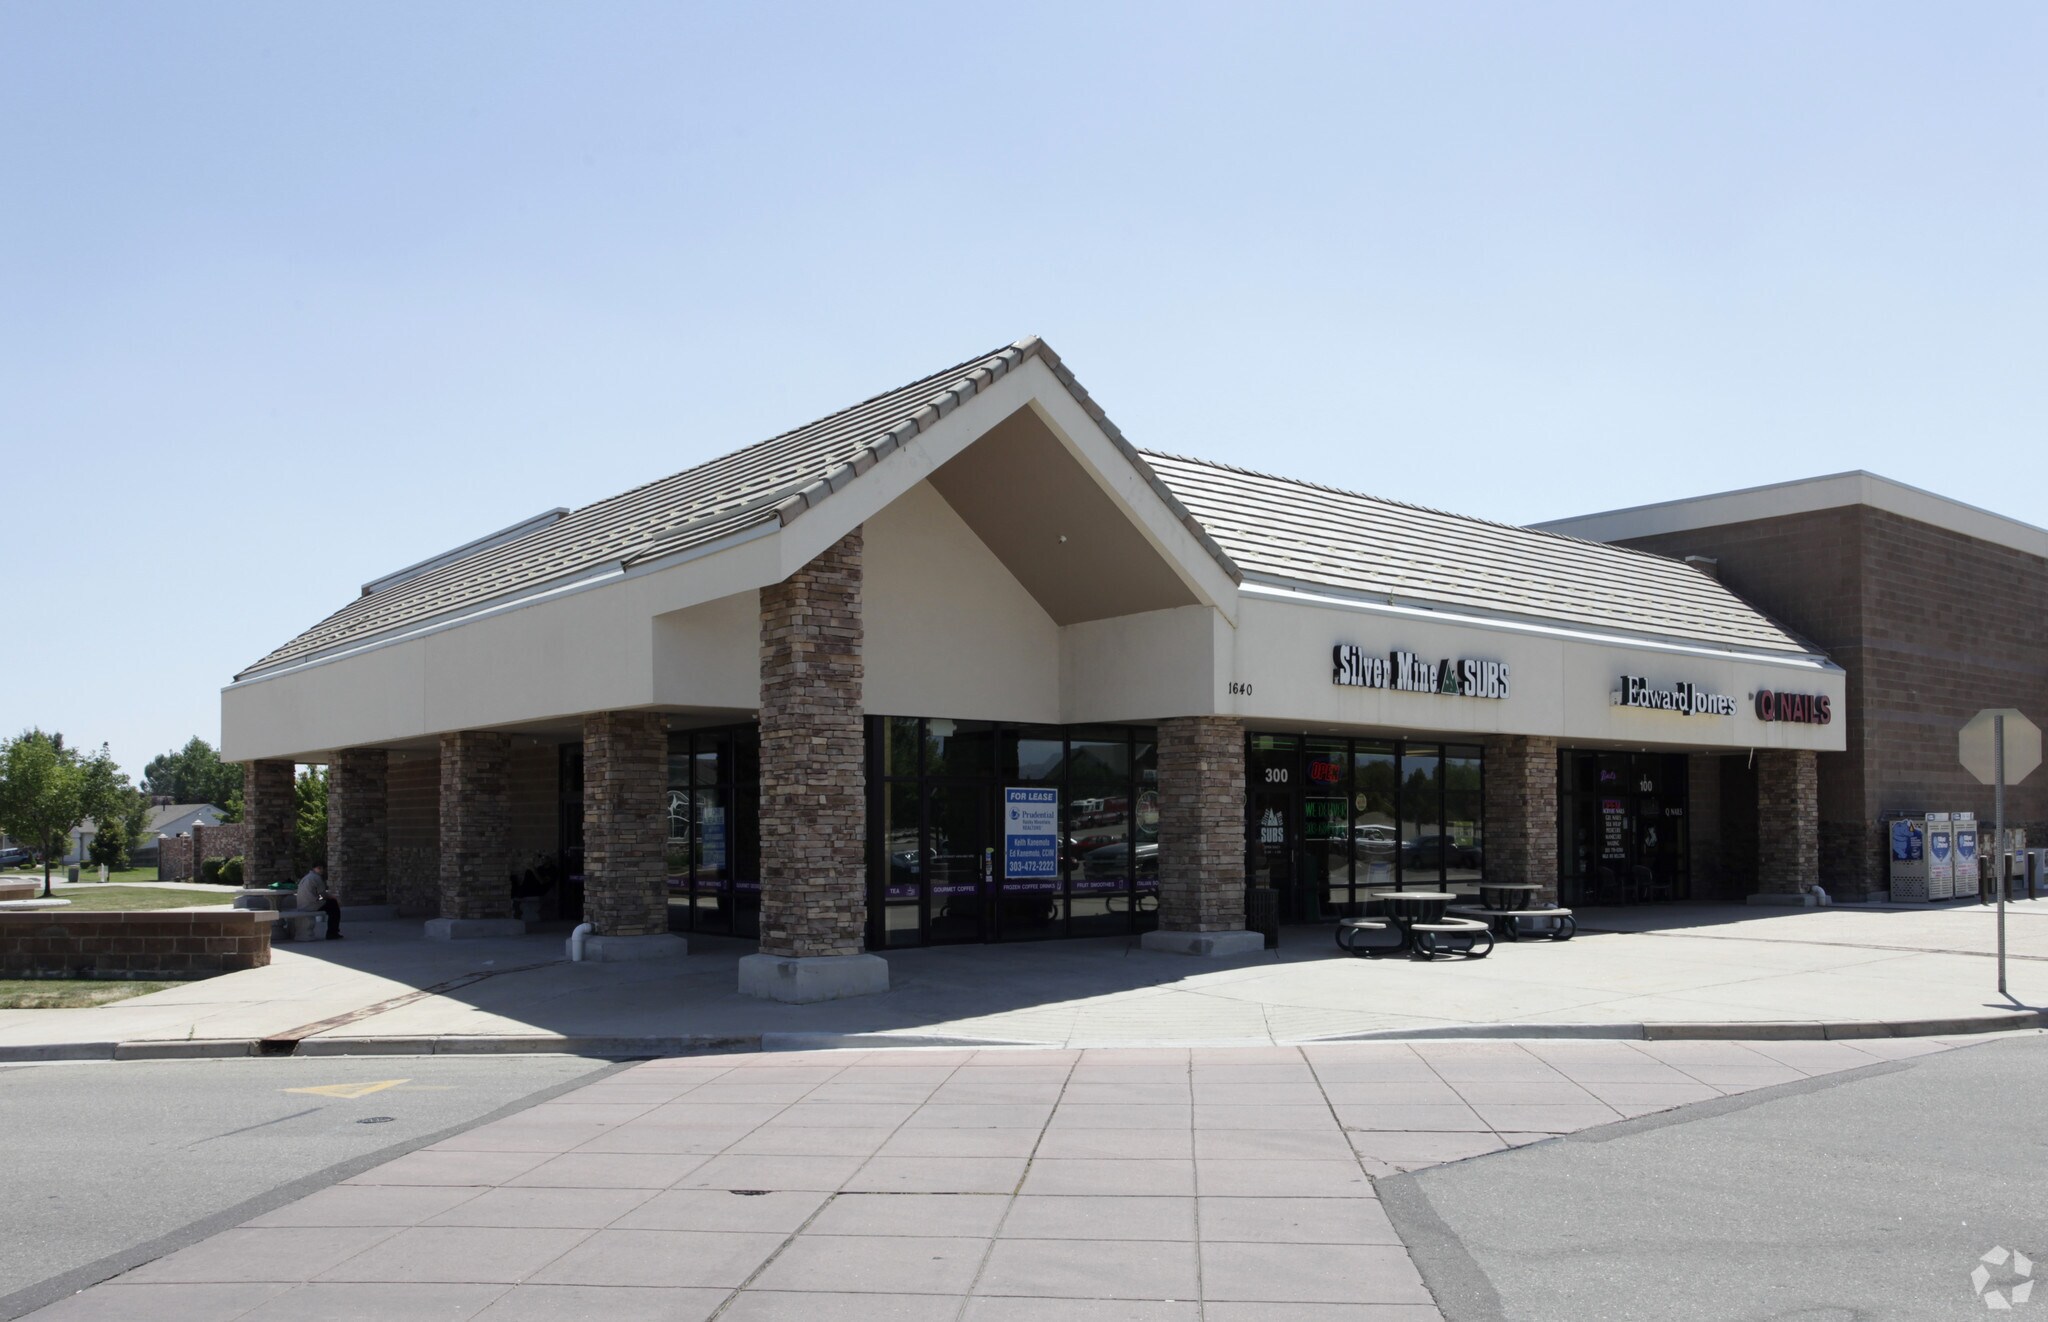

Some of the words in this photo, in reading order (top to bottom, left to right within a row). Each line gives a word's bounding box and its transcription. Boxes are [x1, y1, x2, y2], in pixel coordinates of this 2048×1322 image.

[1335, 645, 1391, 692] Silver
[1393, 651, 1438, 694] Mine
[1461, 660, 1511, 699] SUBS
[1228, 682, 1253, 697] 1640
[1624, 676, 1690, 711] Edward
[1689, 682, 1737, 715] Jones
[1758, 689, 1775, 721] Q
[1777, 692, 1831, 724] NAILS
[1265, 768, 1289, 783] 300
[1311, 762, 1341, 783] OPEN
[1639, 780, 1653, 792] 100
[1010, 792, 1027, 801] FOR
[1028, 793, 1054, 801] LEASE
[1022, 811, 1055, 819] Prudential
[1261, 827, 1284, 843] SUBS
[1009, 849, 1017, 857] Ed
[1009, 861, 1054, 872] 303-472-2222
